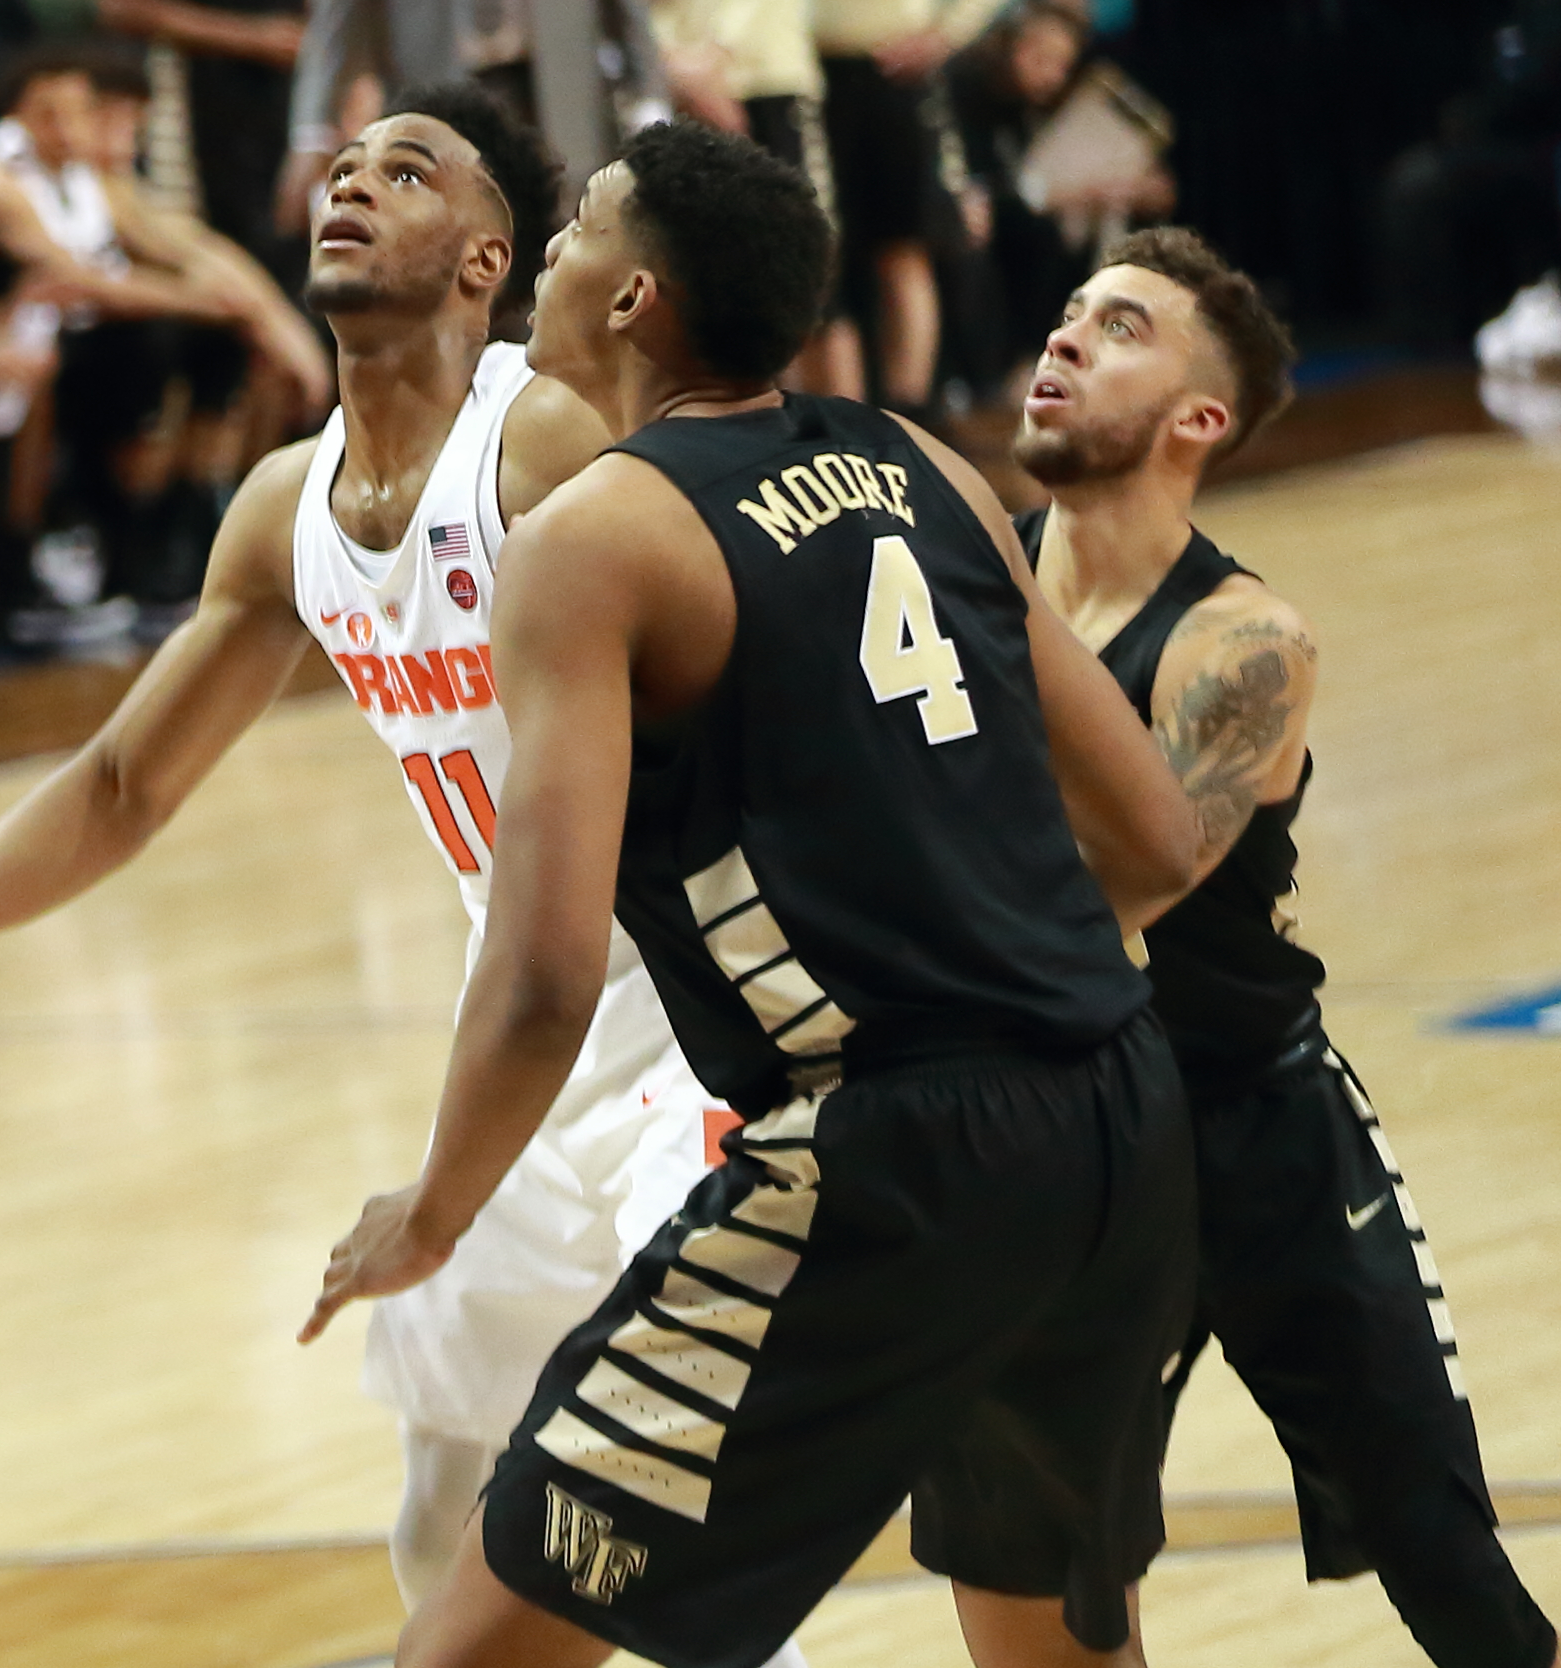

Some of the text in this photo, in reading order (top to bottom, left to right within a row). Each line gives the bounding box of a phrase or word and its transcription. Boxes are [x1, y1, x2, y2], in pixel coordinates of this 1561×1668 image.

[736, 452, 917, 556] MOORE
[859, 535, 979, 745] 4
[401, 749, 497, 876] 11
